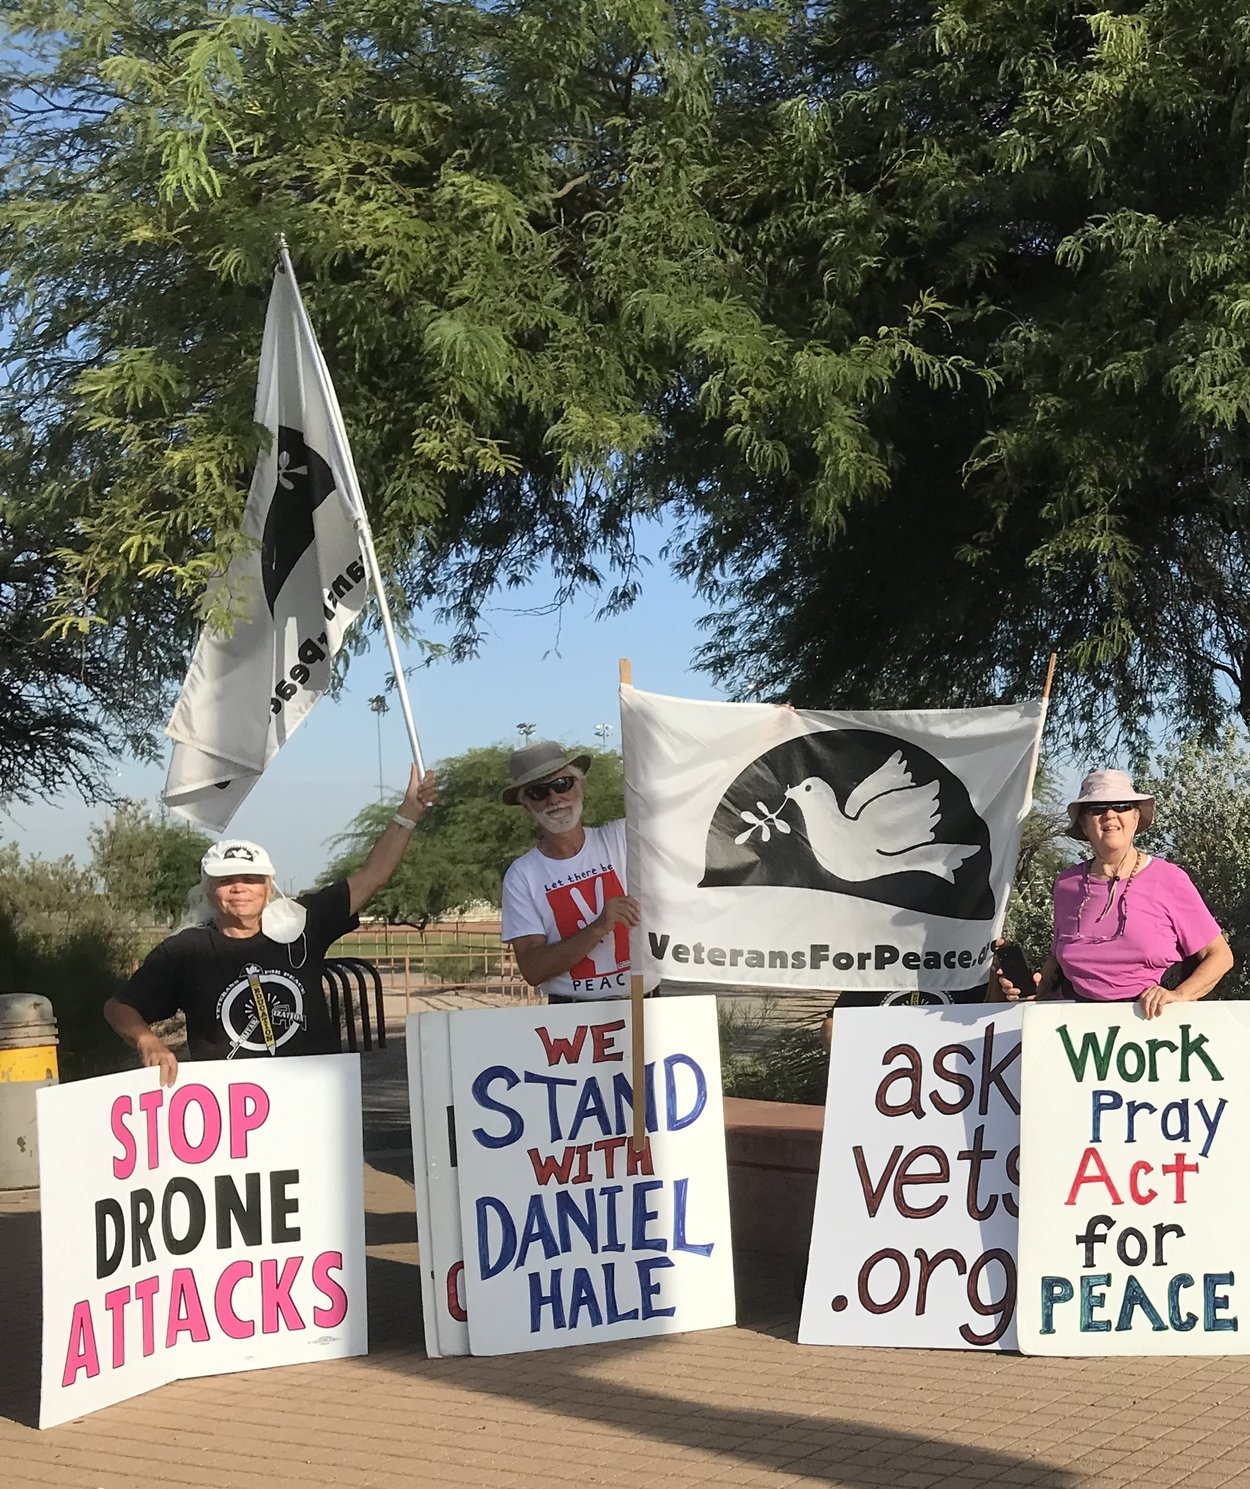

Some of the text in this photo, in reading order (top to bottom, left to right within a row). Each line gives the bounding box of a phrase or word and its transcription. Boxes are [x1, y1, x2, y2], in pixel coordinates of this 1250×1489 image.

[544, 863, 614, 892] Let there be
[573, 973, 626, 991] PEAC
[537, 1019, 626, 1066] WE
[875, 1022, 1021, 1119] ask
[1056, 1024, 1224, 1082] Work
[112, 1082, 270, 1180] STOP
[472, 1053, 706, 1149] STAND
[1090, 1090, 1228, 1158] Pray
[530, 1137, 654, 1187] WITH
[1064, 1147, 1199, 1206] Act
[95, 1169, 302, 1279] DRONE
[475, 1177, 714, 1281] DANIEL
[1076, 1215, 1186, 1268] for
[62, 1251, 348, 1388] ATTACKS
[529, 1256, 676, 1333] HALE
[831, 1247, 1017, 1346] .org
[1039, 1270, 1238, 1335] PEACE
